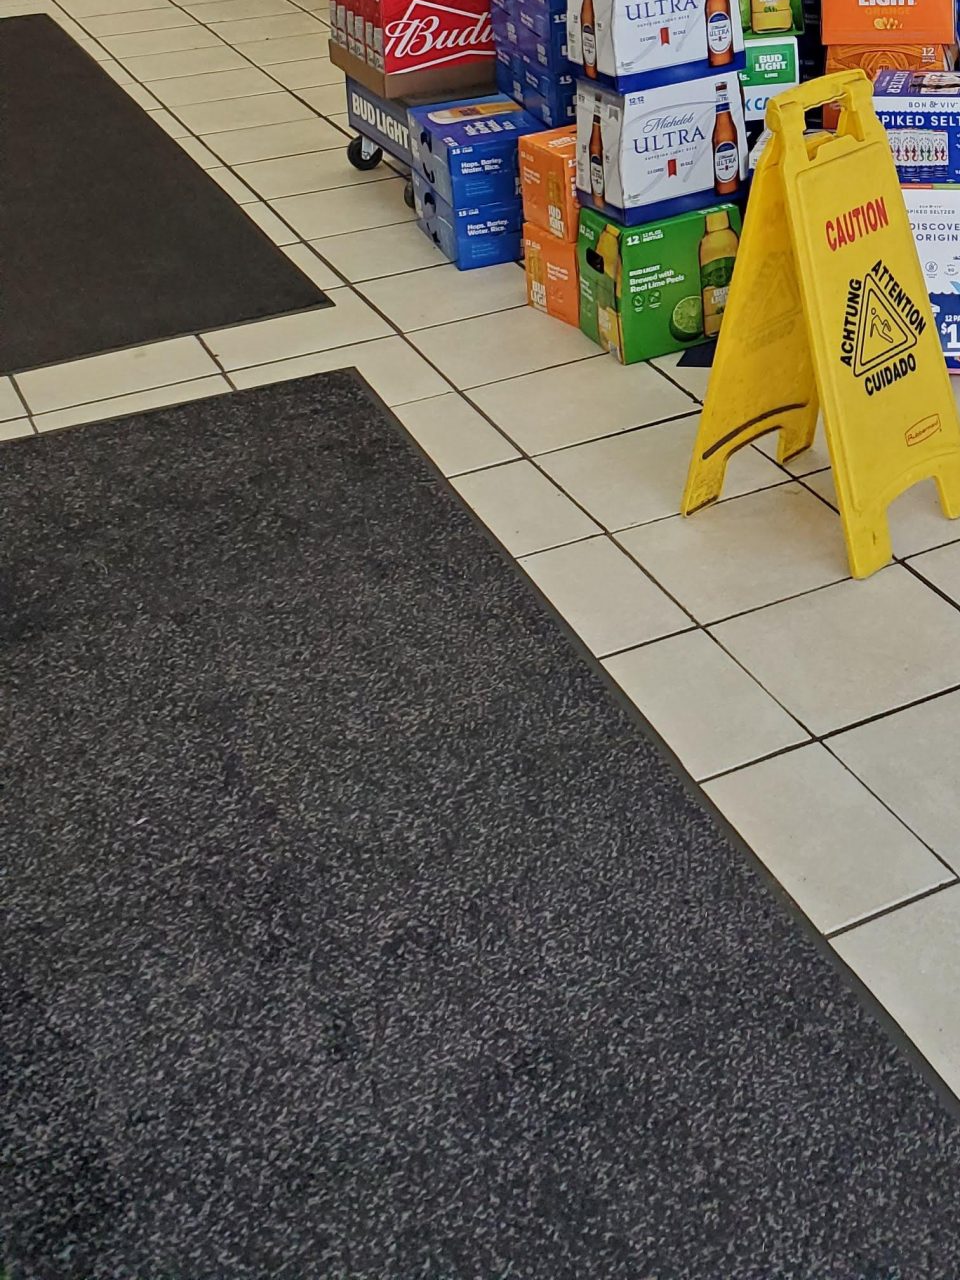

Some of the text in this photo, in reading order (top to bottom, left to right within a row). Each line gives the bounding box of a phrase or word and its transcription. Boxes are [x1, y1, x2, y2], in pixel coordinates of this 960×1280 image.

[755, 60, 788, 71] LIGHT
[759, 53, 782, 63] BUD
[352, 93, 410, 149] BUD LIGHT
[642, 112, 694, 134] Michelob
[633, 125, 705, 154] ULTRA
[824, 196, 889, 252] CAUTION
[626, 235, 640, 246] 12
[629, 269, 675, 285] Brewed with
[630, 274, 685, 293] Real Lime Peels
[871, 259, 927, 336] ATTENTION
[840, 277, 862, 368] ACHTUNG
[864, 353, 917, 397] CUIDADO
[906, 418, 941, 443] Rubbermaid
